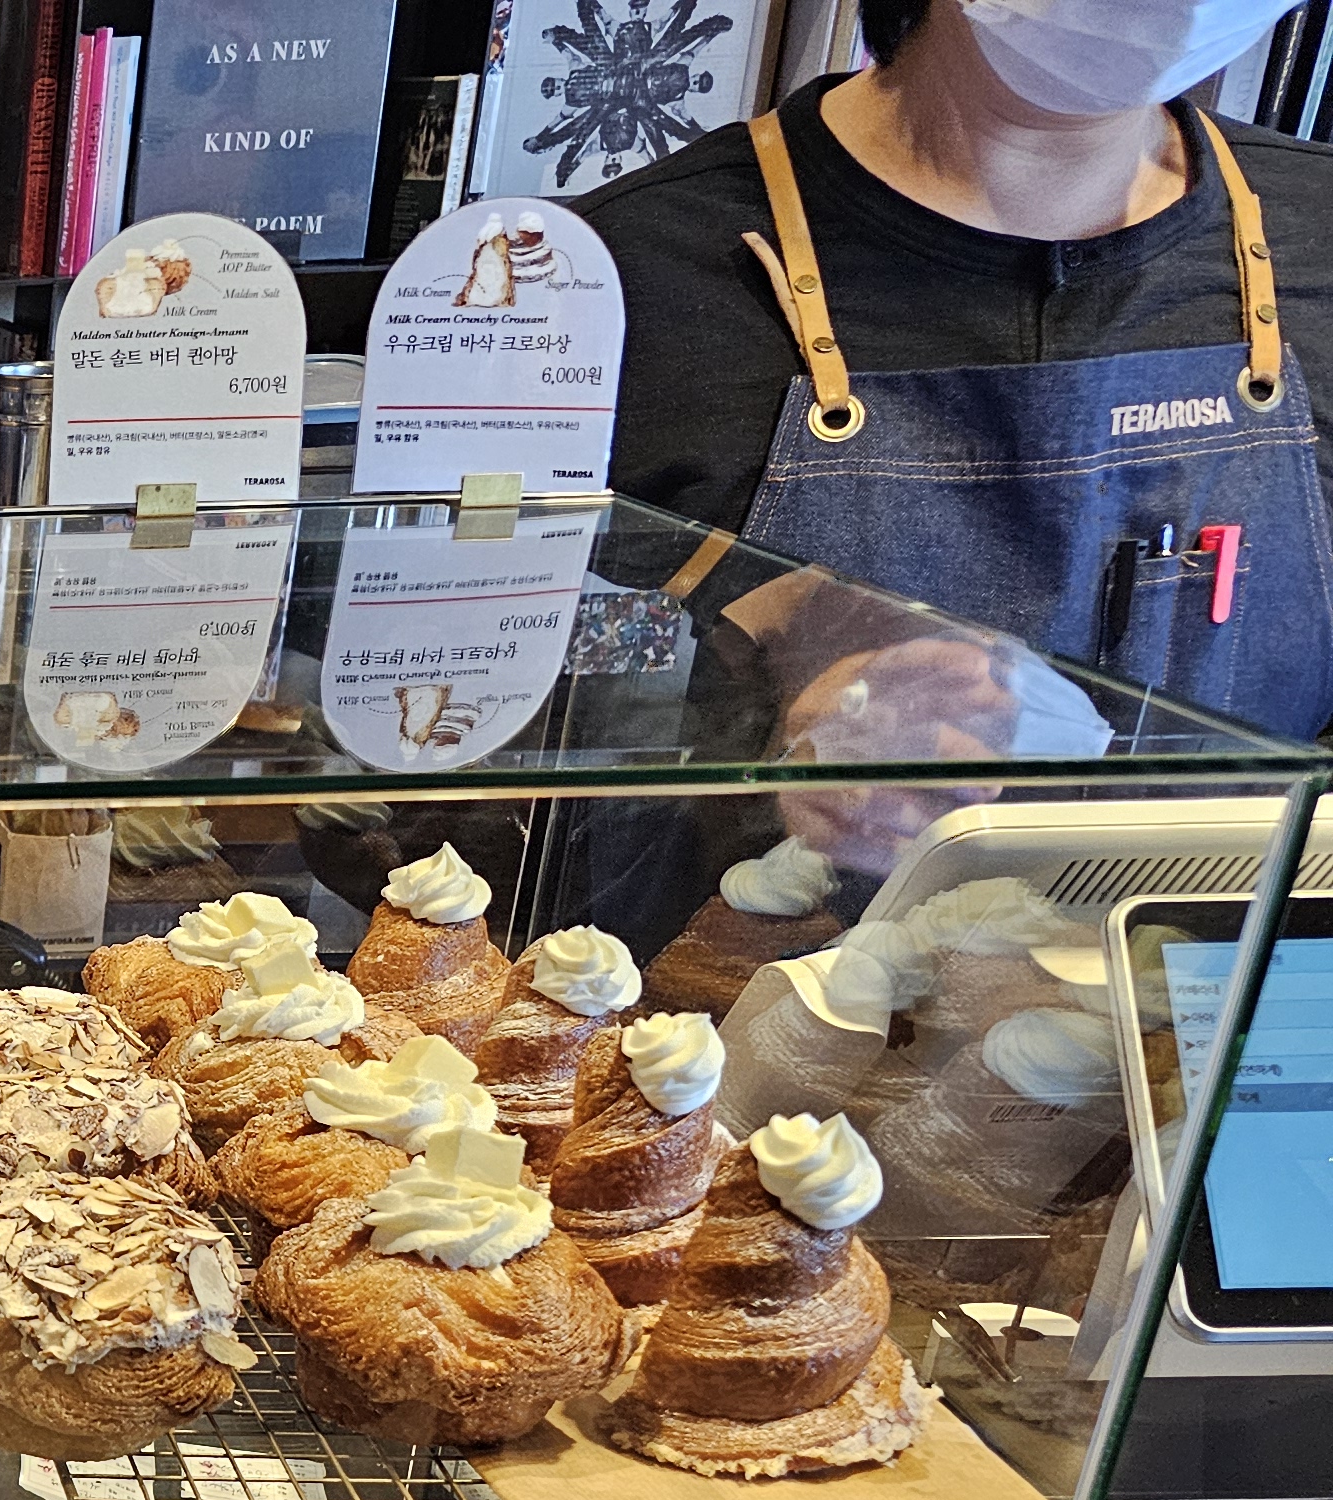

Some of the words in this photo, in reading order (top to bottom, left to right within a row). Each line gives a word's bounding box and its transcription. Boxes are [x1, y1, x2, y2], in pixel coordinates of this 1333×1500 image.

[206, 43, 238, 64] AS
[247, 42, 262, 63] A
[271, 38, 331, 62] NEW
[204, 131, 271, 153] KIND
[280, 128, 313, 149] OF
[255, 215, 325, 234] POEM
[219, 249, 260, 260] Premium
[217, 263, 243, 273] AOP
[245, 262, 272, 272] Butter
[572, 280, 605, 290] Powder
[222, 288, 259, 299] Maldon
[261, 288, 281, 298] Salt
[394, 287, 419, 298] Milk
[422, 287, 451, 297] Cream
[163, 306, 186, 317] Milk
[189, 306, 218, 316] Cream
[386, 315, 413, 325] Milk
[415, 315, 451, 324] Cream
[453, 315, 499, 326] Crunchy
[71, 331, 111, 341] Maldon
[113, 330, 133, 339] Salt
[136, 329, 167, 339] butter
[169, 327, 249, 340] Kouign-Amann
[385, 334, 453, 354] 우유크림
[460, 334, 496, 353] 바삭
[499, 334, 572, 354] 크로와상
[71, 350, 105, 369] 말돈
[110, 349, 143, 368] 솔트
[150, 347, 179, 367] 버터
[187, 345, 238, 366] 퀸아망
[541, 366, 603, 386] 6,000원
[229, 375, 287, 395] 6,700원
[1109, 396, 1234, 436] TERAROSA
[552, 470, 593, 479] TERAROSA
[244, 477, 285, 485] TERAROSA
